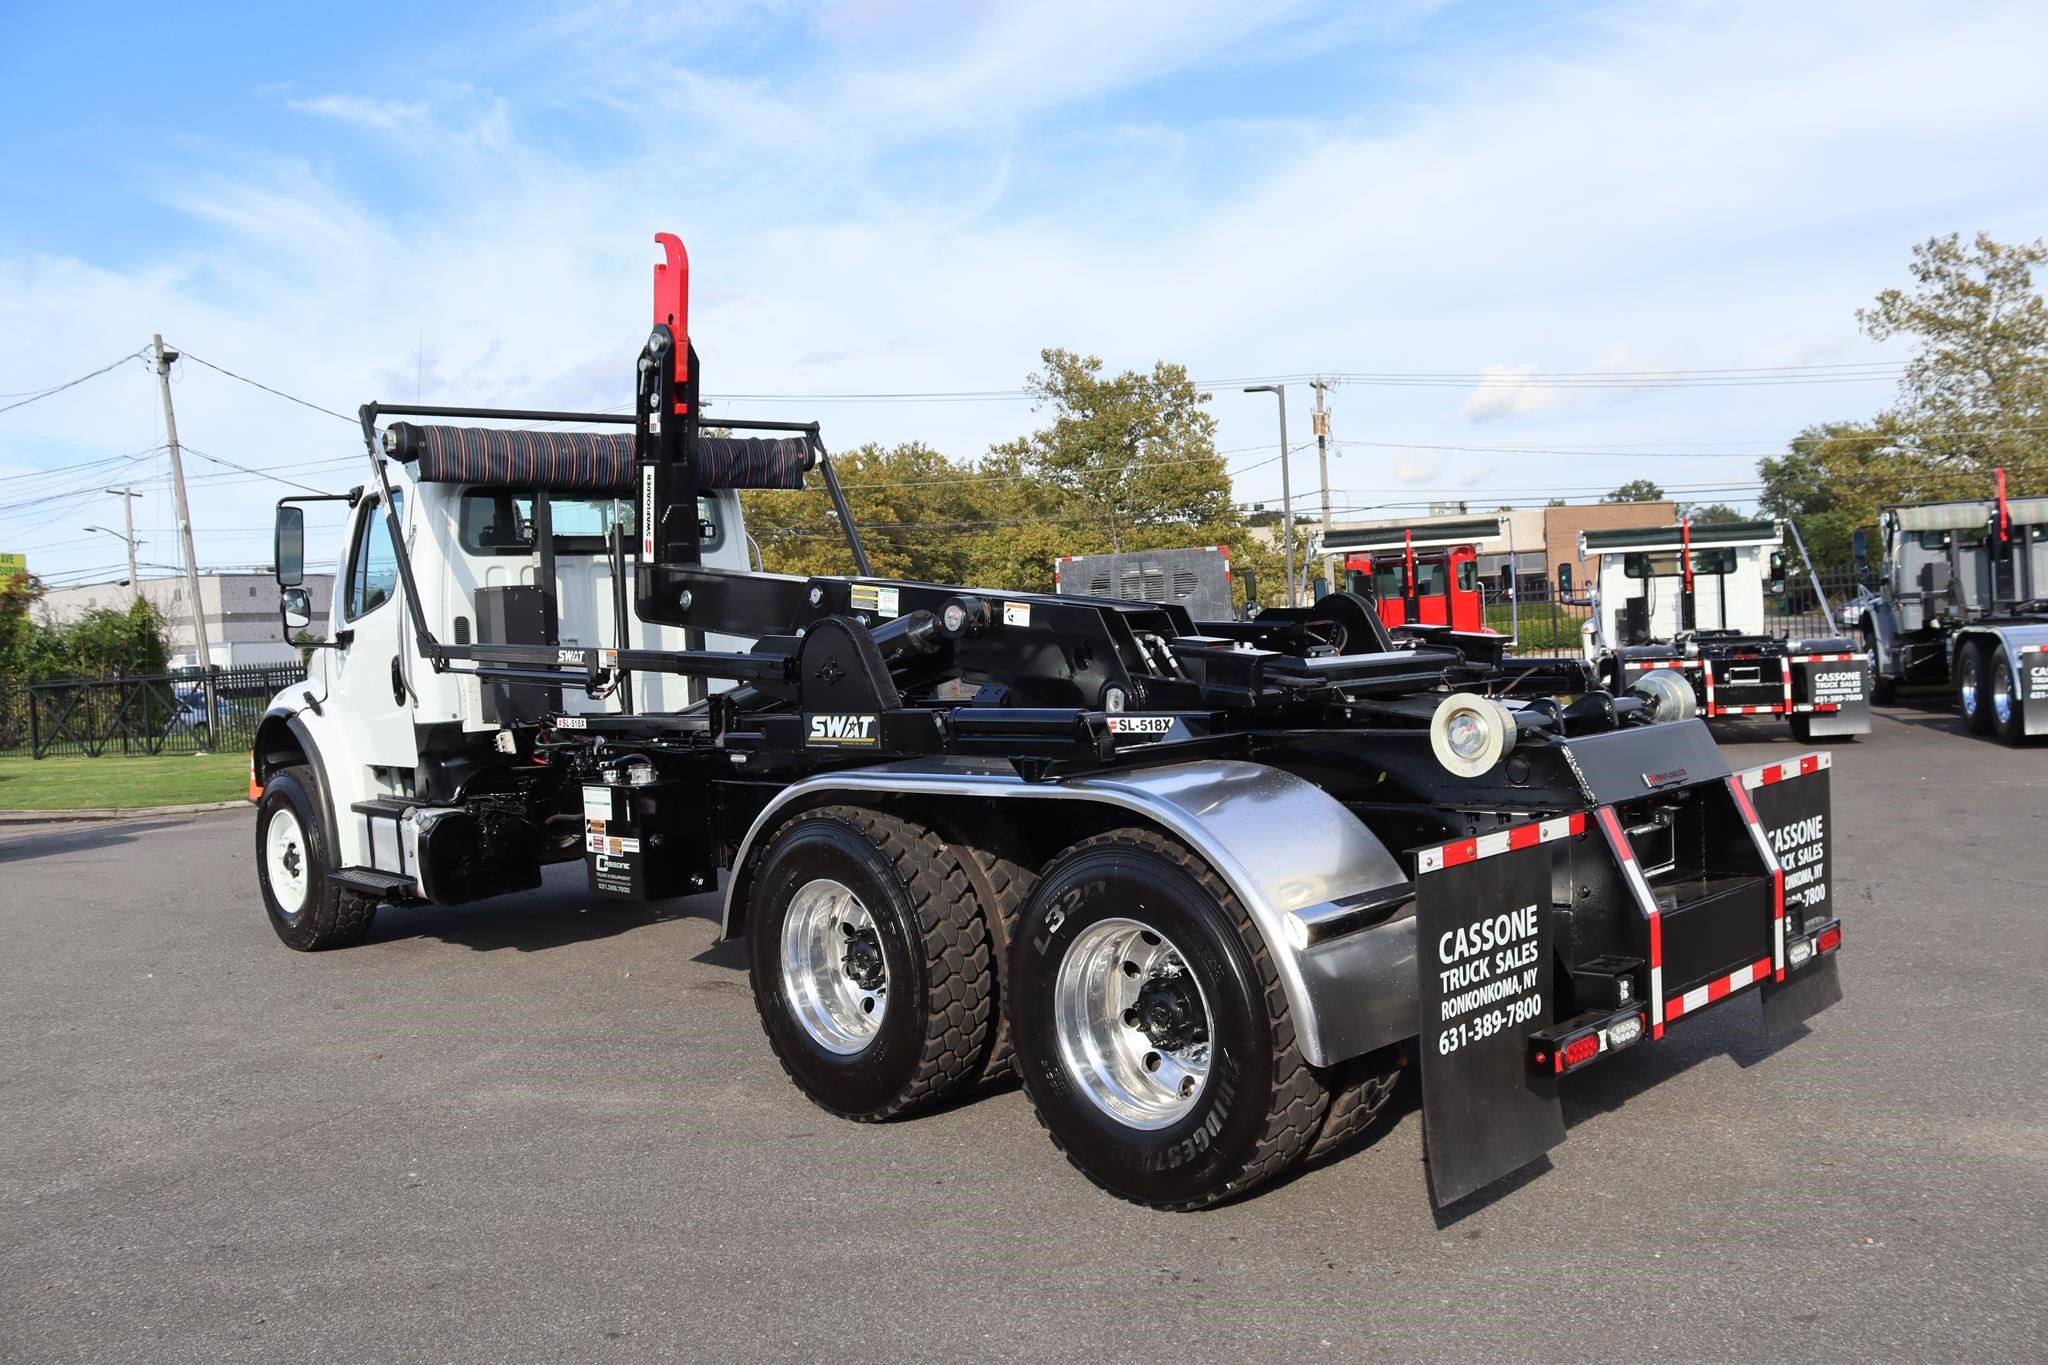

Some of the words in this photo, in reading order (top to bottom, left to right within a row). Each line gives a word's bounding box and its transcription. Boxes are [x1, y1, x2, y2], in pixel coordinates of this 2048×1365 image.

[558, 649, 586, 663] SWAT
[1814, 671, 1861, 682] CASSONE
[809, 715, 875, 738] SWAT
[1119, 719, 1171, 731] SL-518X
[596, 854, 630, 872] CASSONE
[1798, 842, 1823, 866] SALES
[1814, 863, 1823, 879] NY
[1438, 904, 1538, 965] CASSONE
[1440, 957, 1490, 994] TRUCK
[1495, 940, 1538, 974] SALES
[1441, 974, 1523, 1022] RONKONKOMA,
[1523, 967, 1538, 989] NY
[1438, 993, 1541, 1056] 631-389-7800
